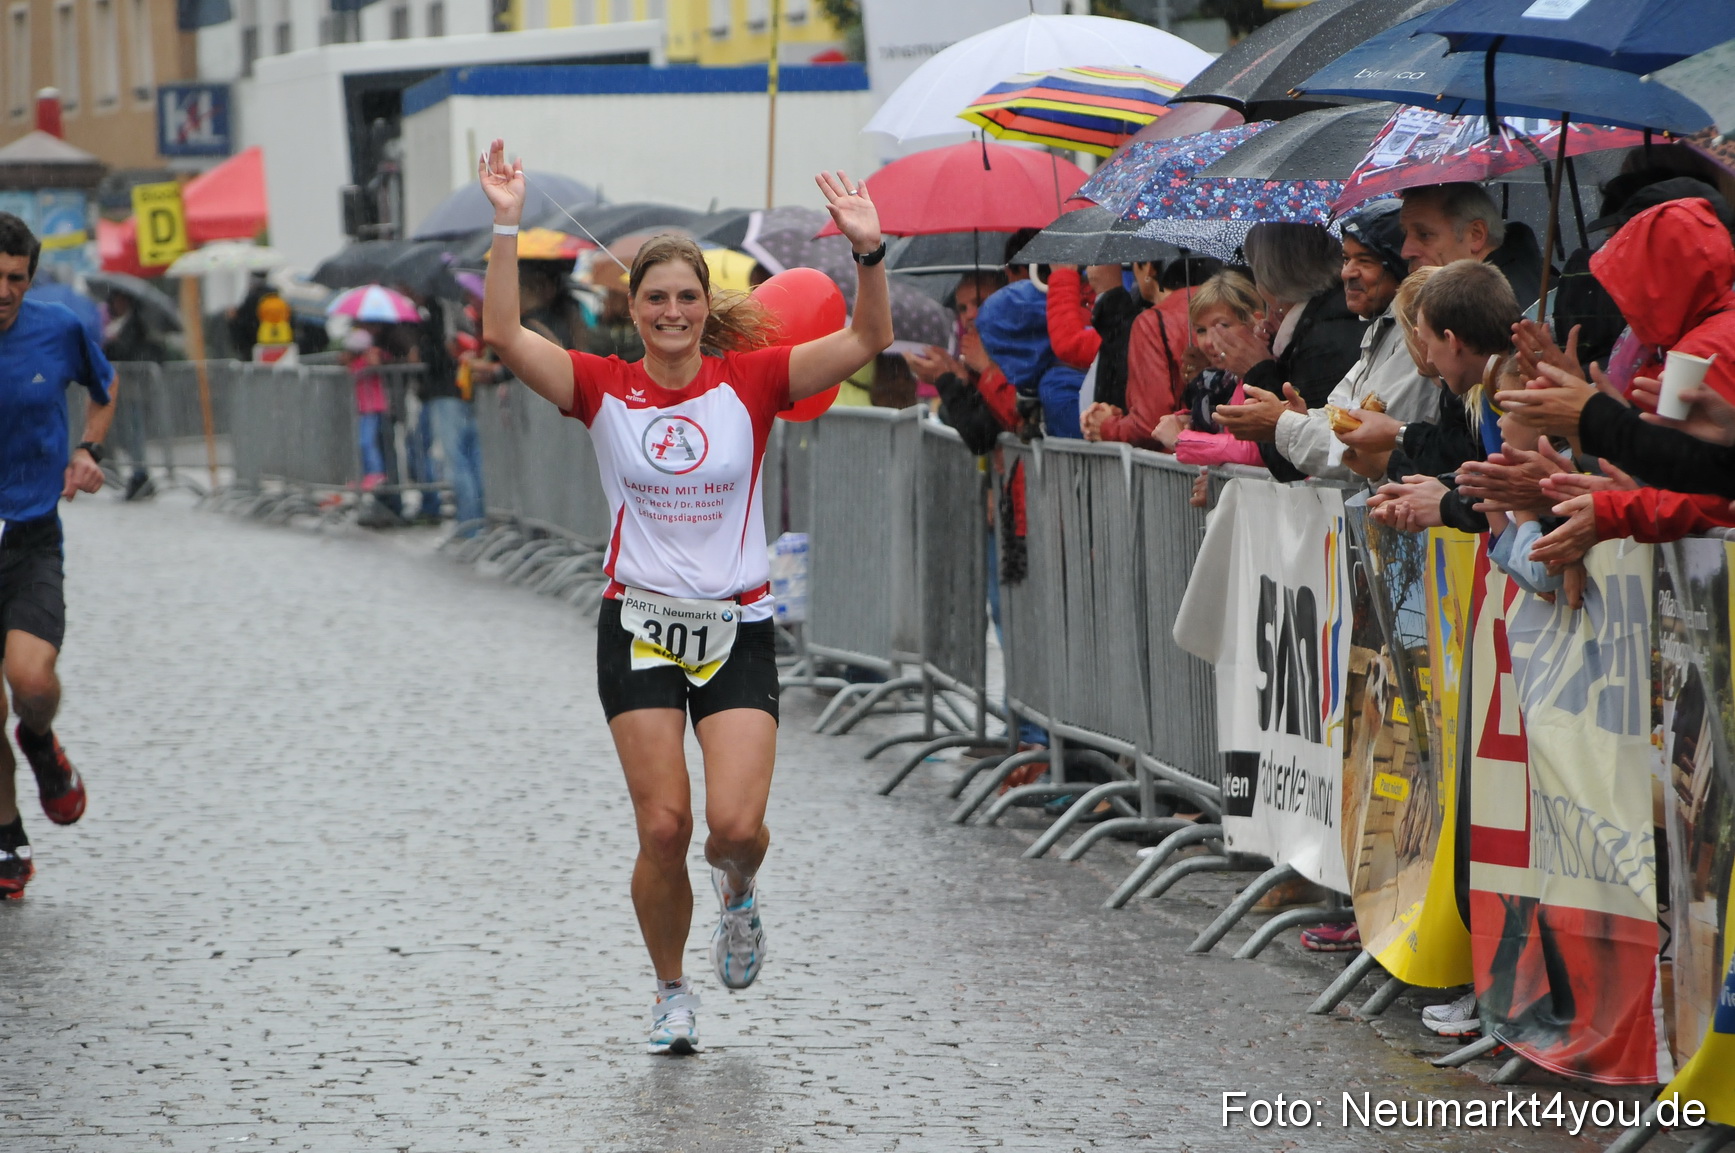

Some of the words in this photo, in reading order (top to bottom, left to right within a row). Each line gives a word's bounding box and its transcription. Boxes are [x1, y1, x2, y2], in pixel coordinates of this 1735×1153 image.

[150, 208, 176, 245] D
[625, 393, 647, 403] erima
[624, 477, 669, 495] LAUFEN
[675, 486, 698, 495] MIT
[704, 482, 735, 494] HERZ
[635, 496, 648, 505] Dr.
[650, 499, 672, 508] Heck
[680, 500, 693, 509] Dr.
[695, 498, 724, 508] Röschl
[638, 507, 723, 524] Leistungsdiagnostik
[625, 597, 660, 615] PARTL
[662, 606, 718, 621] Neumarkt
[642, 619, 709, 662] 301
